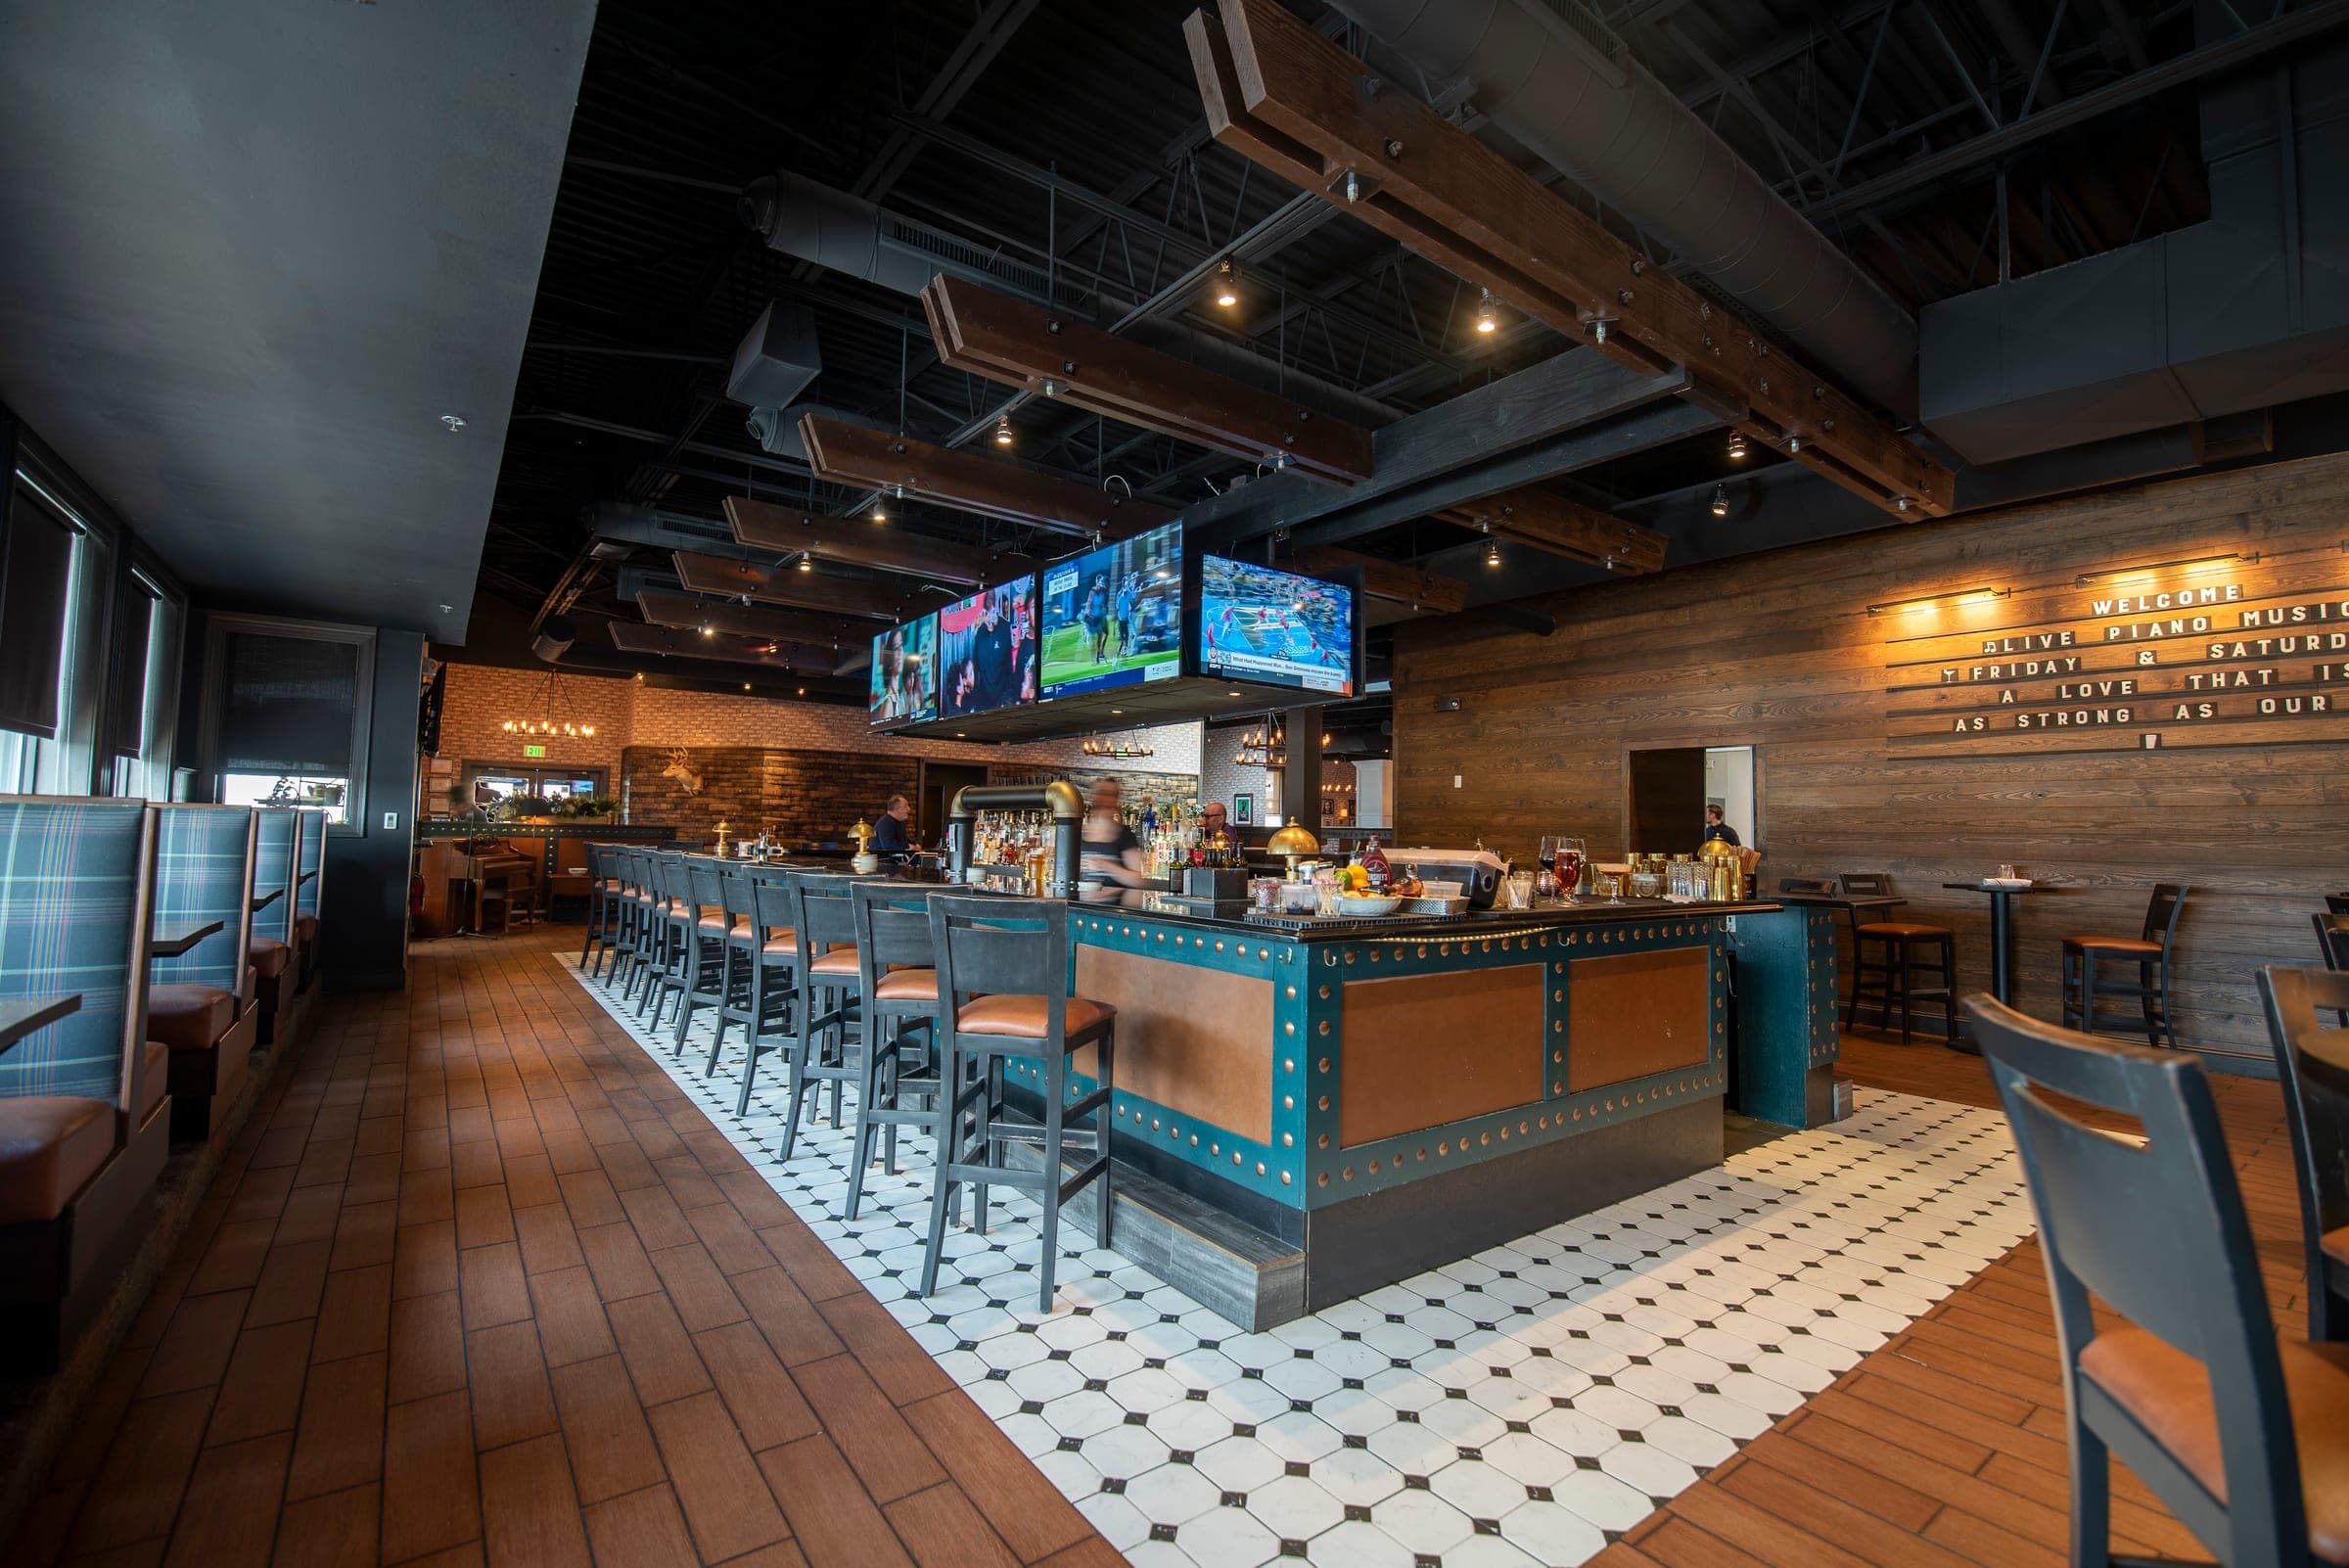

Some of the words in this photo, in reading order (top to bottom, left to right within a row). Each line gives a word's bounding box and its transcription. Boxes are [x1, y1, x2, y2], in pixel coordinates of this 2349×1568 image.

[2092, 584, 2238, 616] WELCOME
[2004, 631, 2072, 652] LIVE
[2109, 617, 2207, 640] PIANO
[2242, 601, 2349, 626] MUSIC
[1973, 657, 2076, 680] FRIDAY
[2139, 650, 2155, 666] &
[2210, 632, 2346, 659] SATURD
[2002, 689, 2014, 704] A
[2061, 680, 2133, 699] LOVE
[2188, 669, 2273, 690] THAT
[1956, 716, 1985, 732] AS
[2018, 709, 2130, 728] STRONG
[2176, 703, 2213, 719] AS
[2261, 696, 2326, 714] OUR
